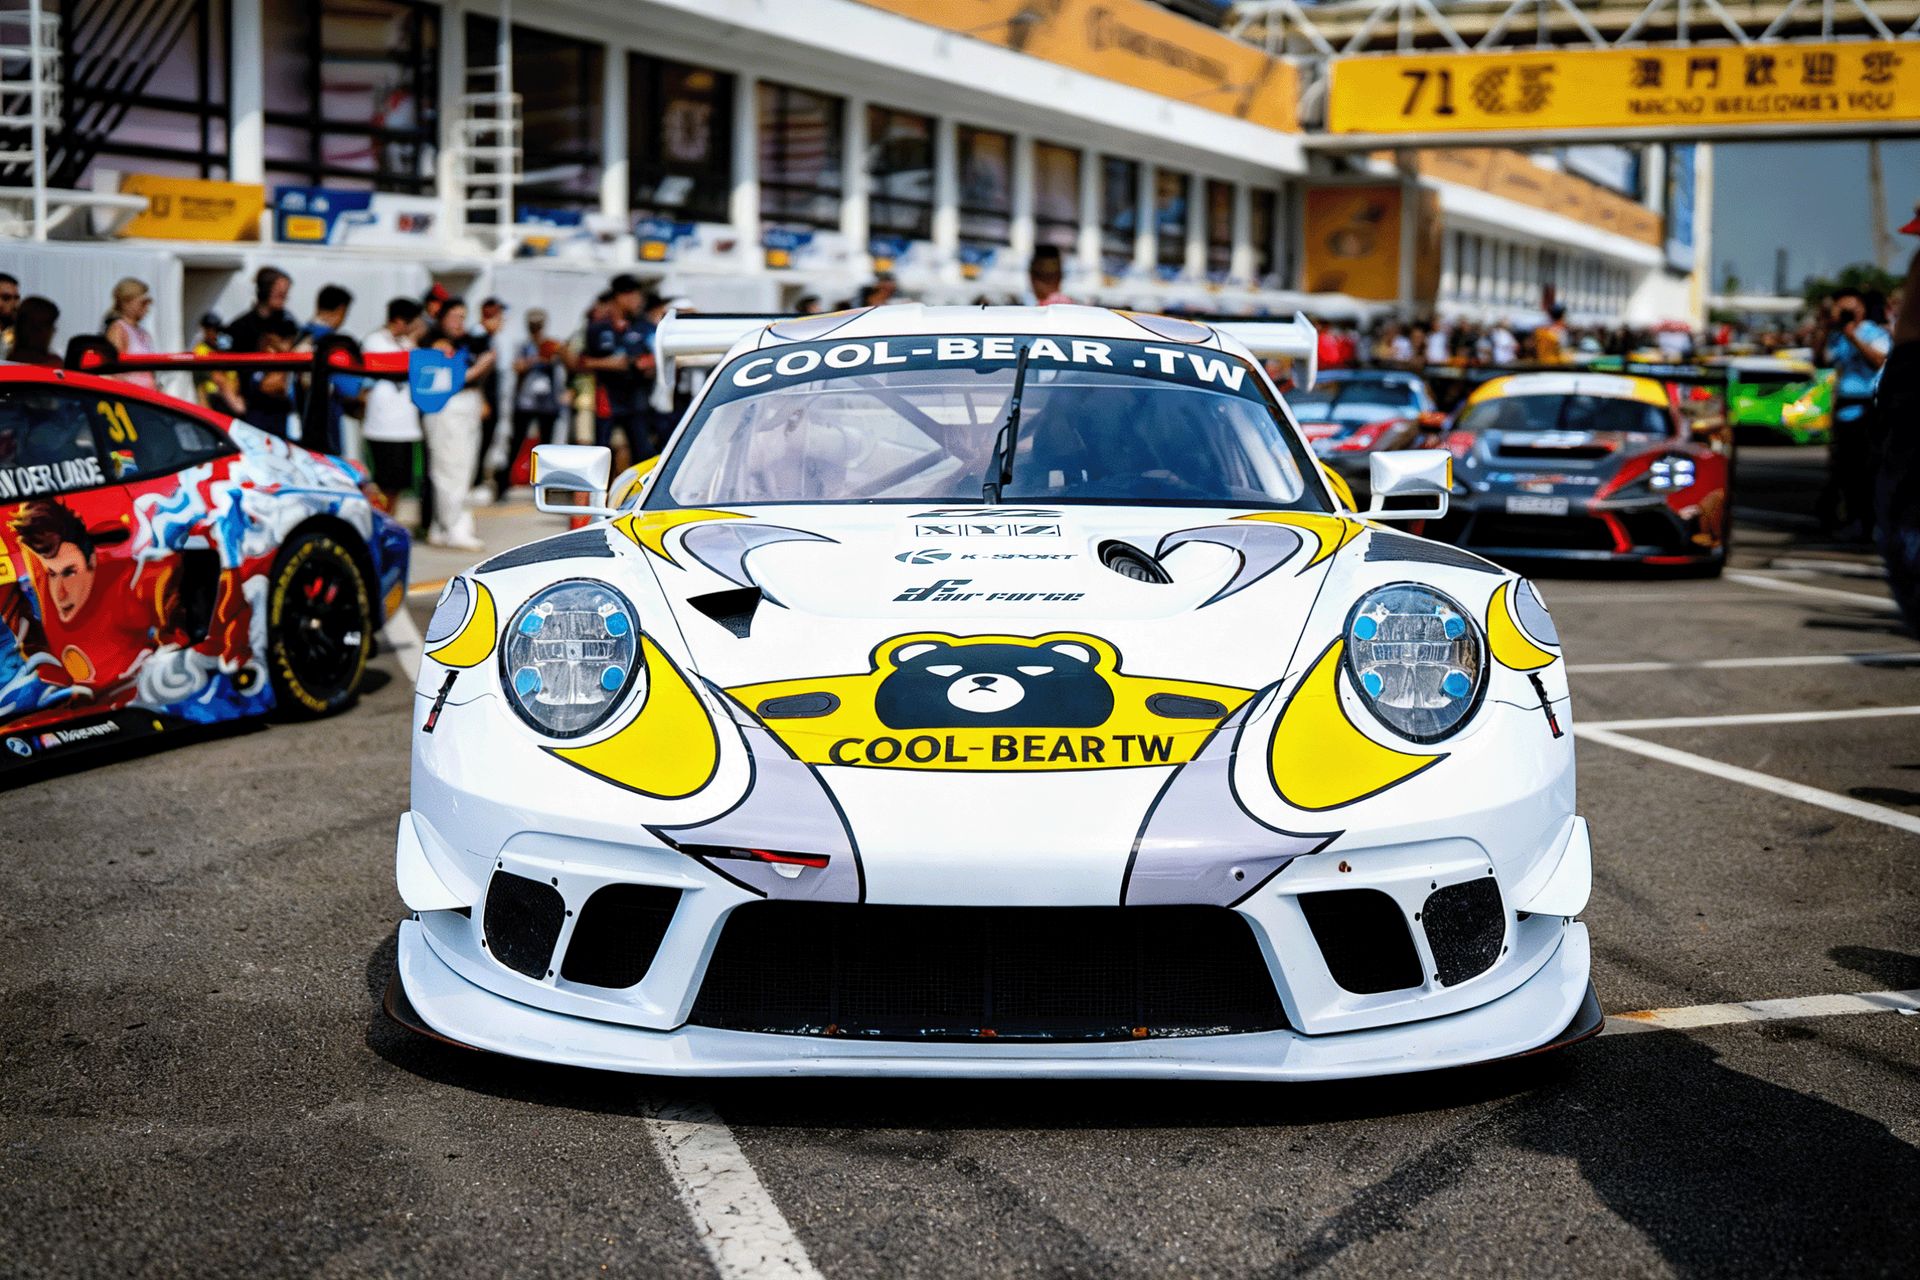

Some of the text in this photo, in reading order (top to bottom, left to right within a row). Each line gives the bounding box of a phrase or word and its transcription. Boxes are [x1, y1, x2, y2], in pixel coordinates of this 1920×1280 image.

[1402, 68, 1455, 115] 71
[1847, 90, 1896, 112] YOU
[732, 337, 1114, 388] COOL-BEAR
[96, 400, 138, 443] 31
[919, 524, 1059, 536] XYZ
[829, 734, 1106, 766] COOL-BEAR
